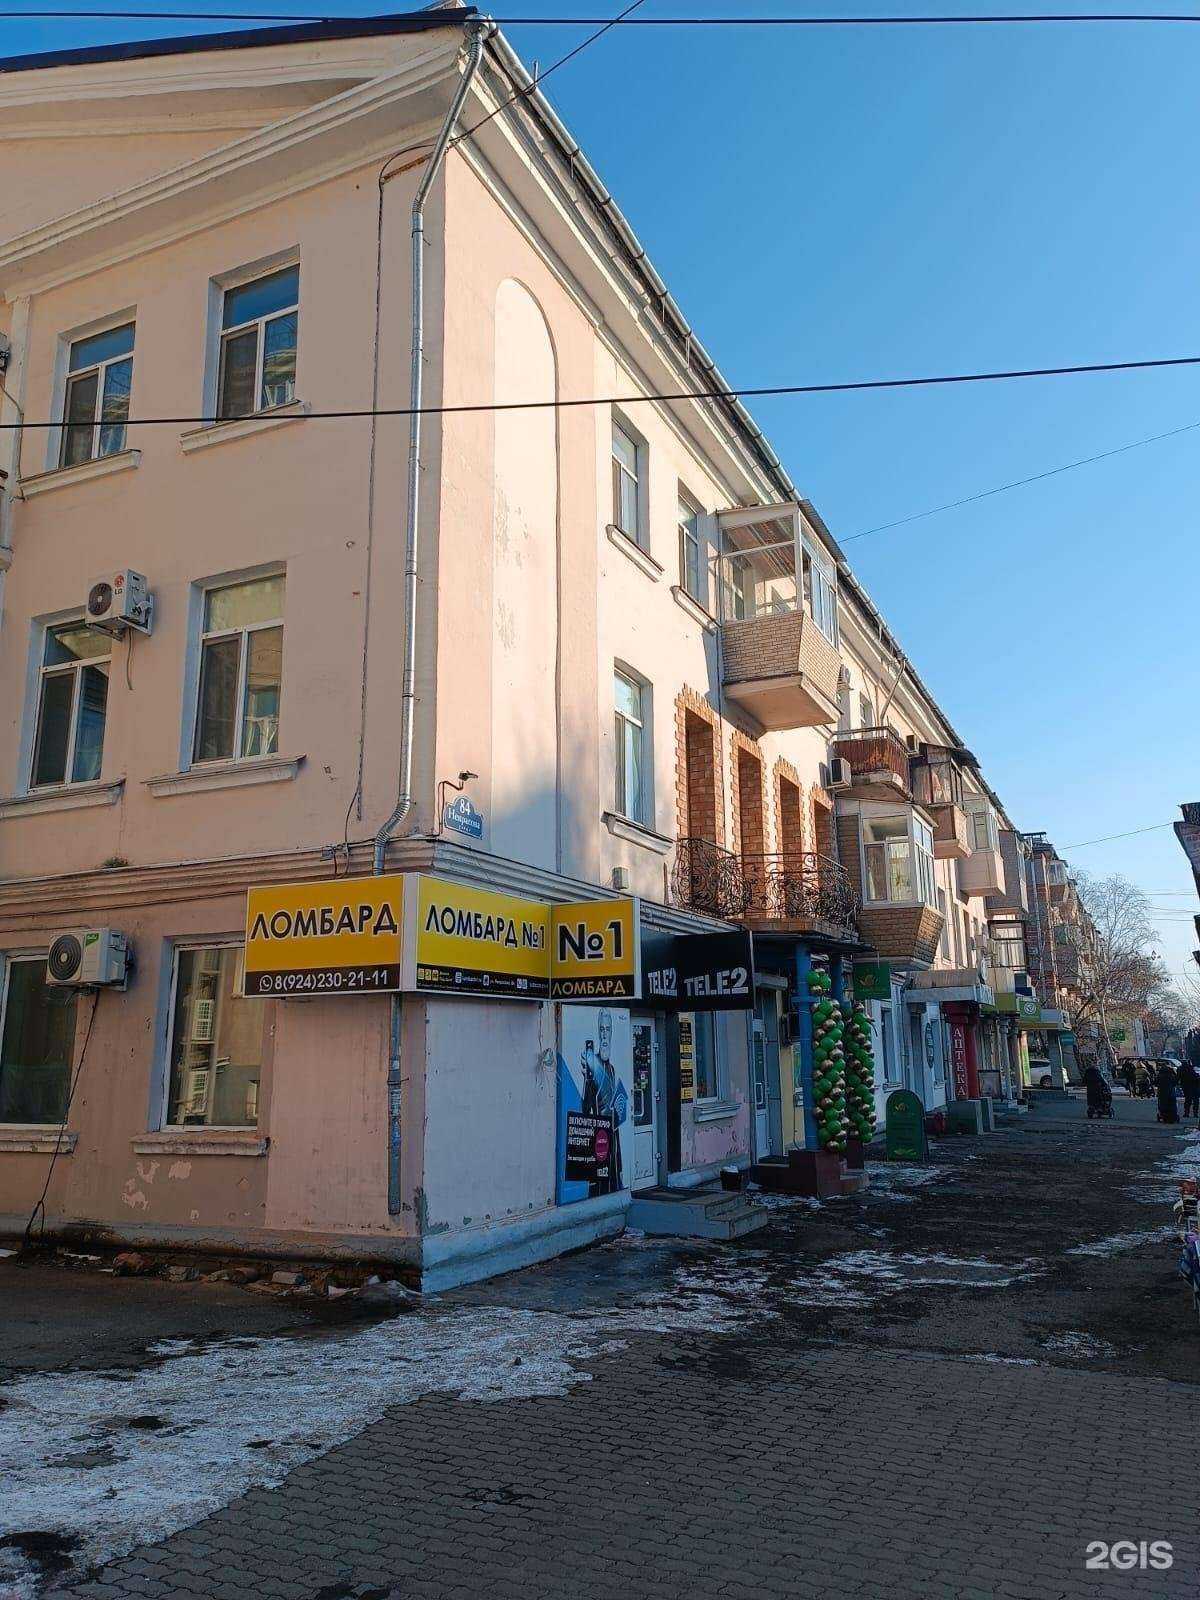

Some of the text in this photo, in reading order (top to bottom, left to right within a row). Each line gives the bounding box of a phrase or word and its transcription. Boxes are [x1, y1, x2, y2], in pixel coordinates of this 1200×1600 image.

[460, 799, 471, 815] 84
[250, 903, 398, 940] ЛОМБАРД
[425, 904, 545, 949] ЛОМБАРД №1
[559, 921, 622, 961] №1
[274, 969, 388, 991] 8(924)230-21-11
[552, 980, 626, 996] ЛОМБАРД
[648, 967, 677, 996] TELE2
[684, 966, 749, 996] TELE2
[953, 1026, 967, 1095] АПТЕКА
